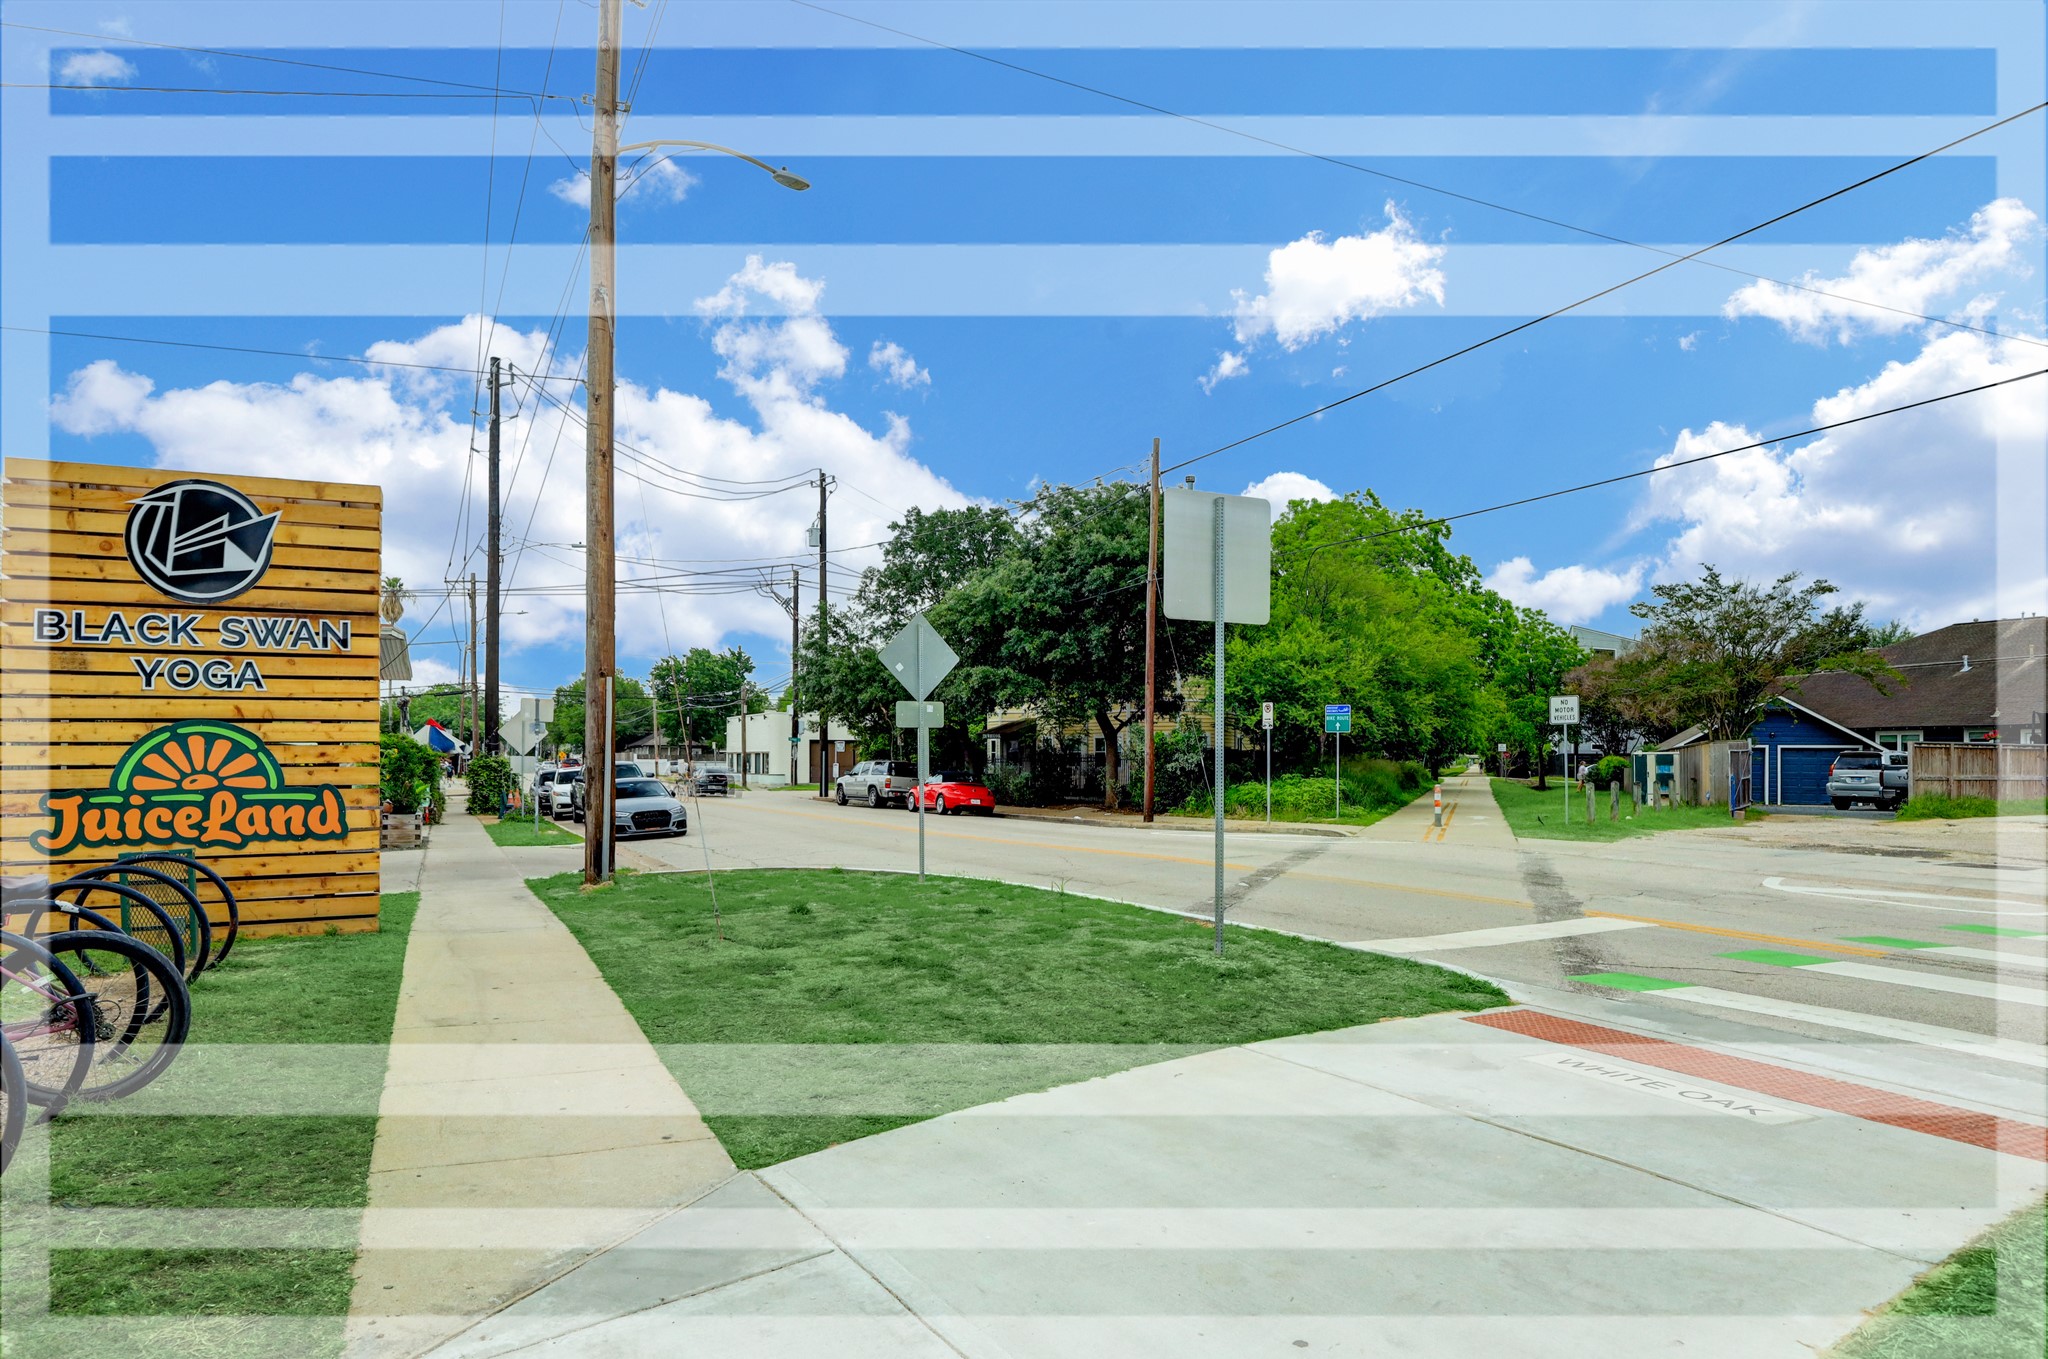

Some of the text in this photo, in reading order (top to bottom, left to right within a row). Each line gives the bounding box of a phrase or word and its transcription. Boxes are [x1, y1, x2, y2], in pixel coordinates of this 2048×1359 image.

[33, 608, 352, 651] BLACK SWAN
[130, 657, 267, 692] YOGA
[36, 789, 343, 850] JuiceLand
[1557, 1058, 1773, 1116] WHITE OAK
